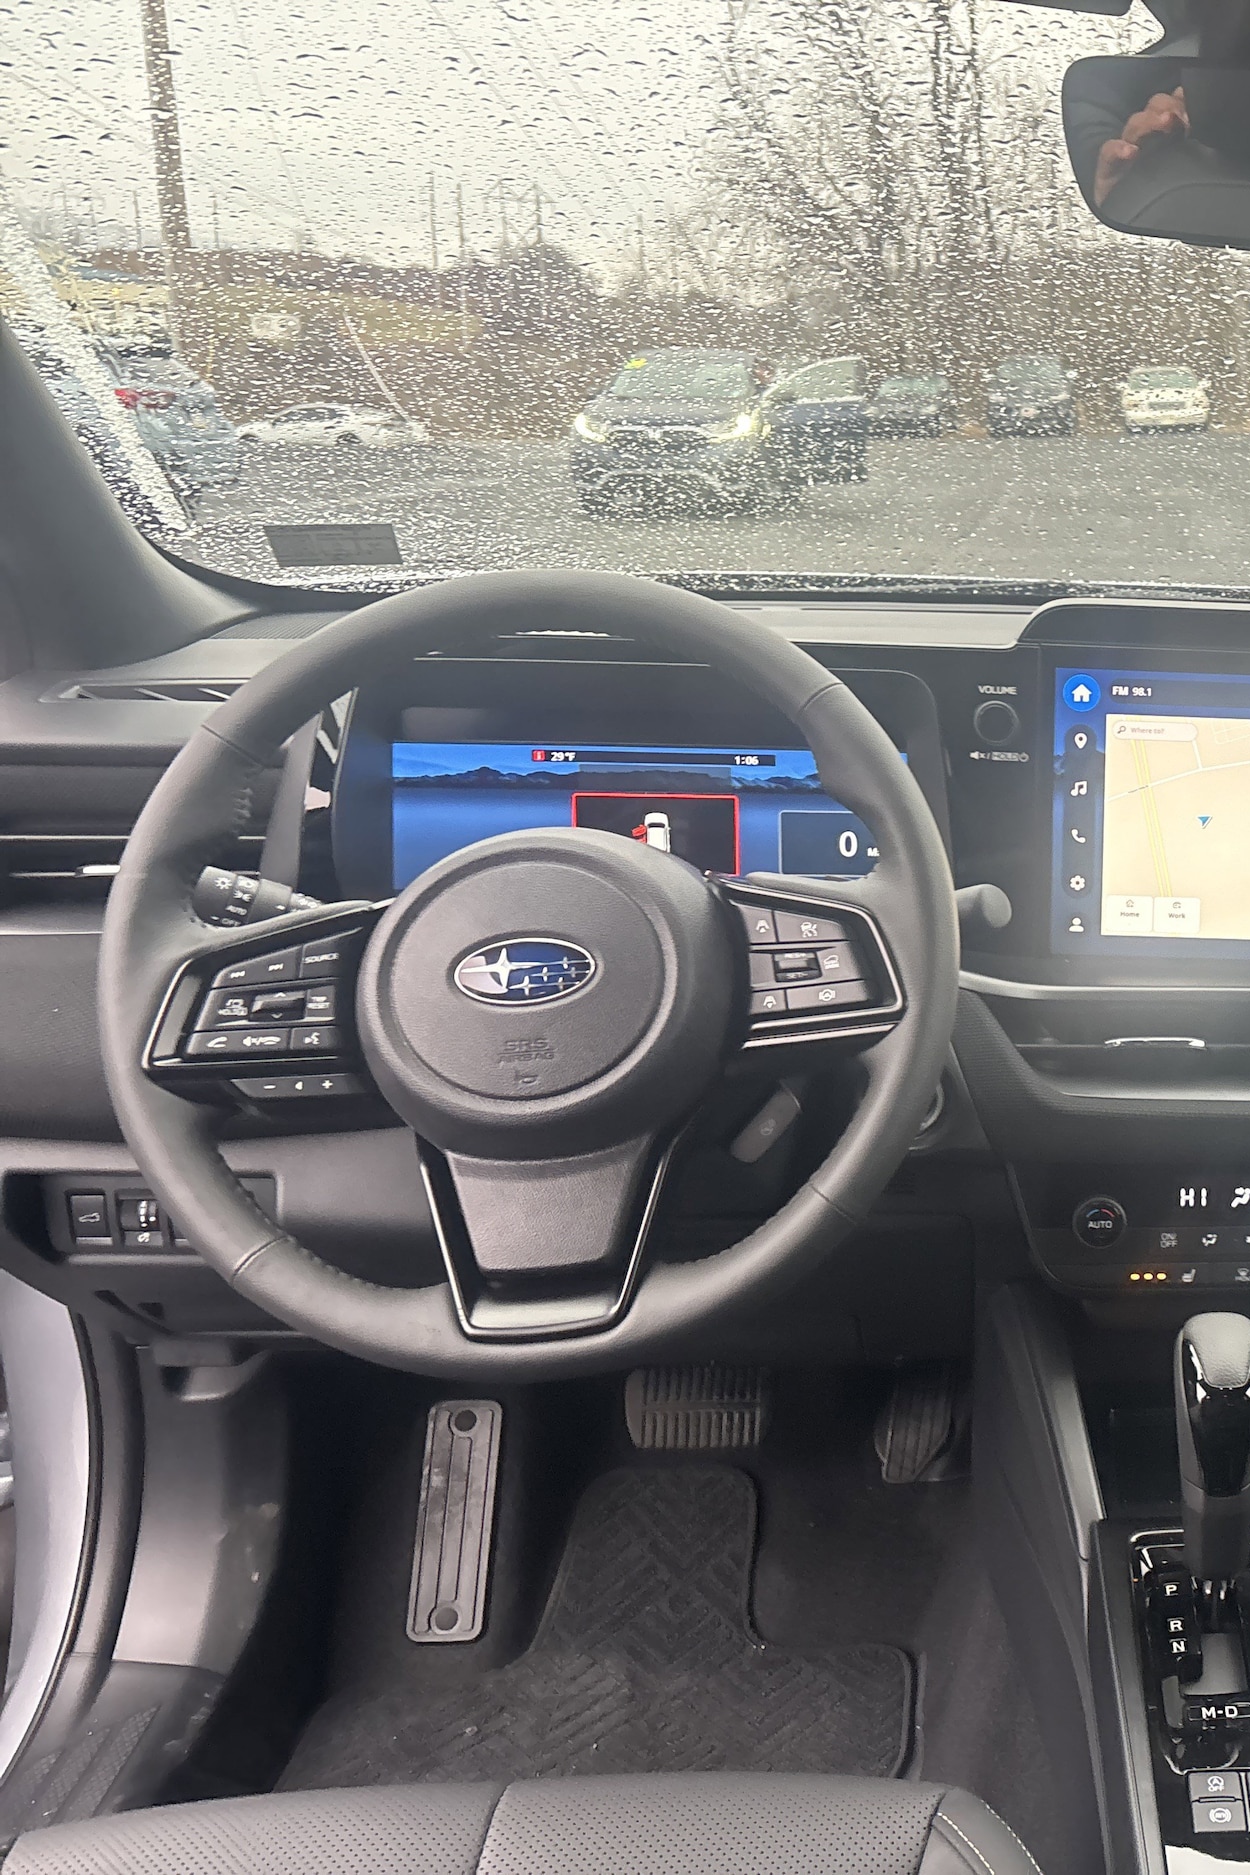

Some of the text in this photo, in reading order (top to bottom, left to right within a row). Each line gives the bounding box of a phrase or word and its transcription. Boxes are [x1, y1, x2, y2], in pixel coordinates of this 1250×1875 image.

[978, 685, 1018, 695] VOLUME
[1112, 686, 1152, 697] FM 98.1
[1130, 726, 1154, 735] Where
[734, 755, 759, 766] 1:06
[839, 830, 858, 858] 0
[1168, 912, 1186, 920] Work
[304, 952, 340, 964] SOURCE
[1088, 1221, 1113, 1229] AUTO
[1165, 1584, 1177, 1596] P
[1170, 1620, 1183, 1632] R
[1172, 1640, 1185, 1653] N
